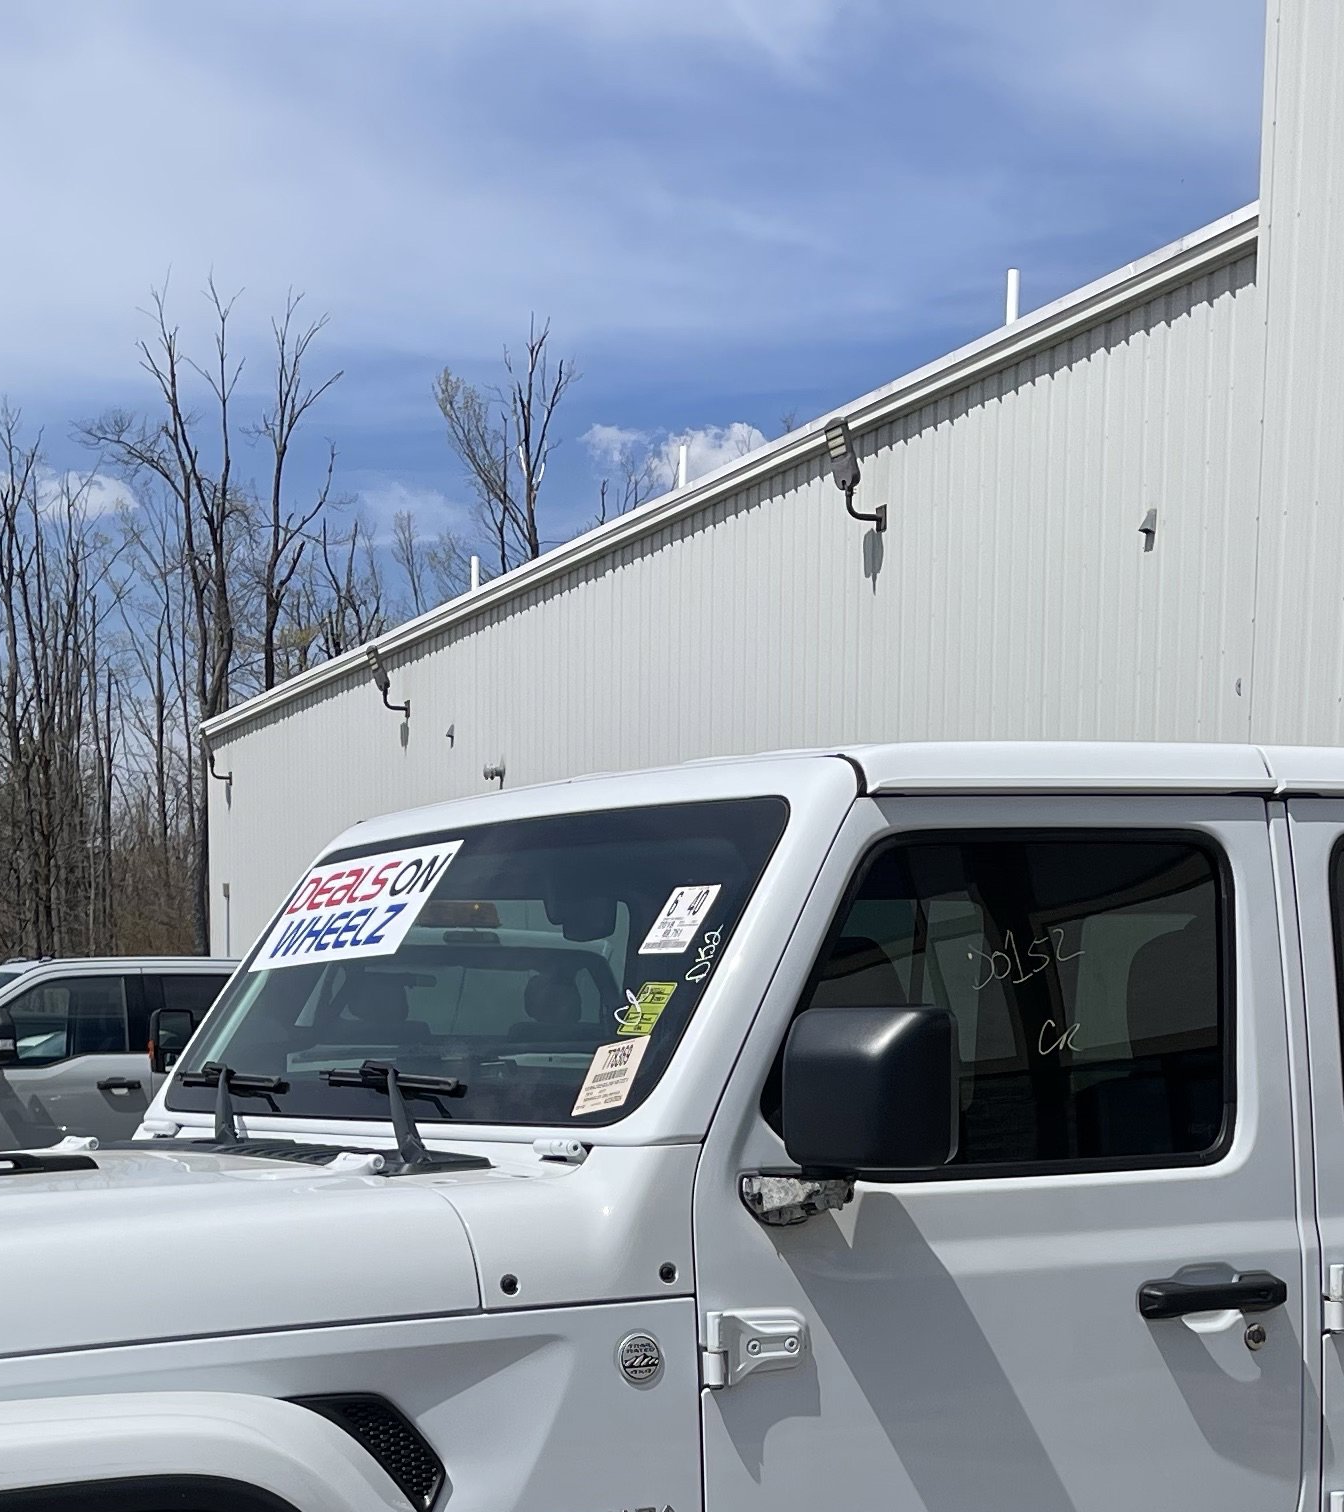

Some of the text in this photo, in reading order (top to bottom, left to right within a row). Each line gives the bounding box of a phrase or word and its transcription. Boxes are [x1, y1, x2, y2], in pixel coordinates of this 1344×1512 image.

[388, 852, 454, 898] ON
[667, 889, 710, 917] 6 40
[268, 902, 409, 960] WHEELZ
